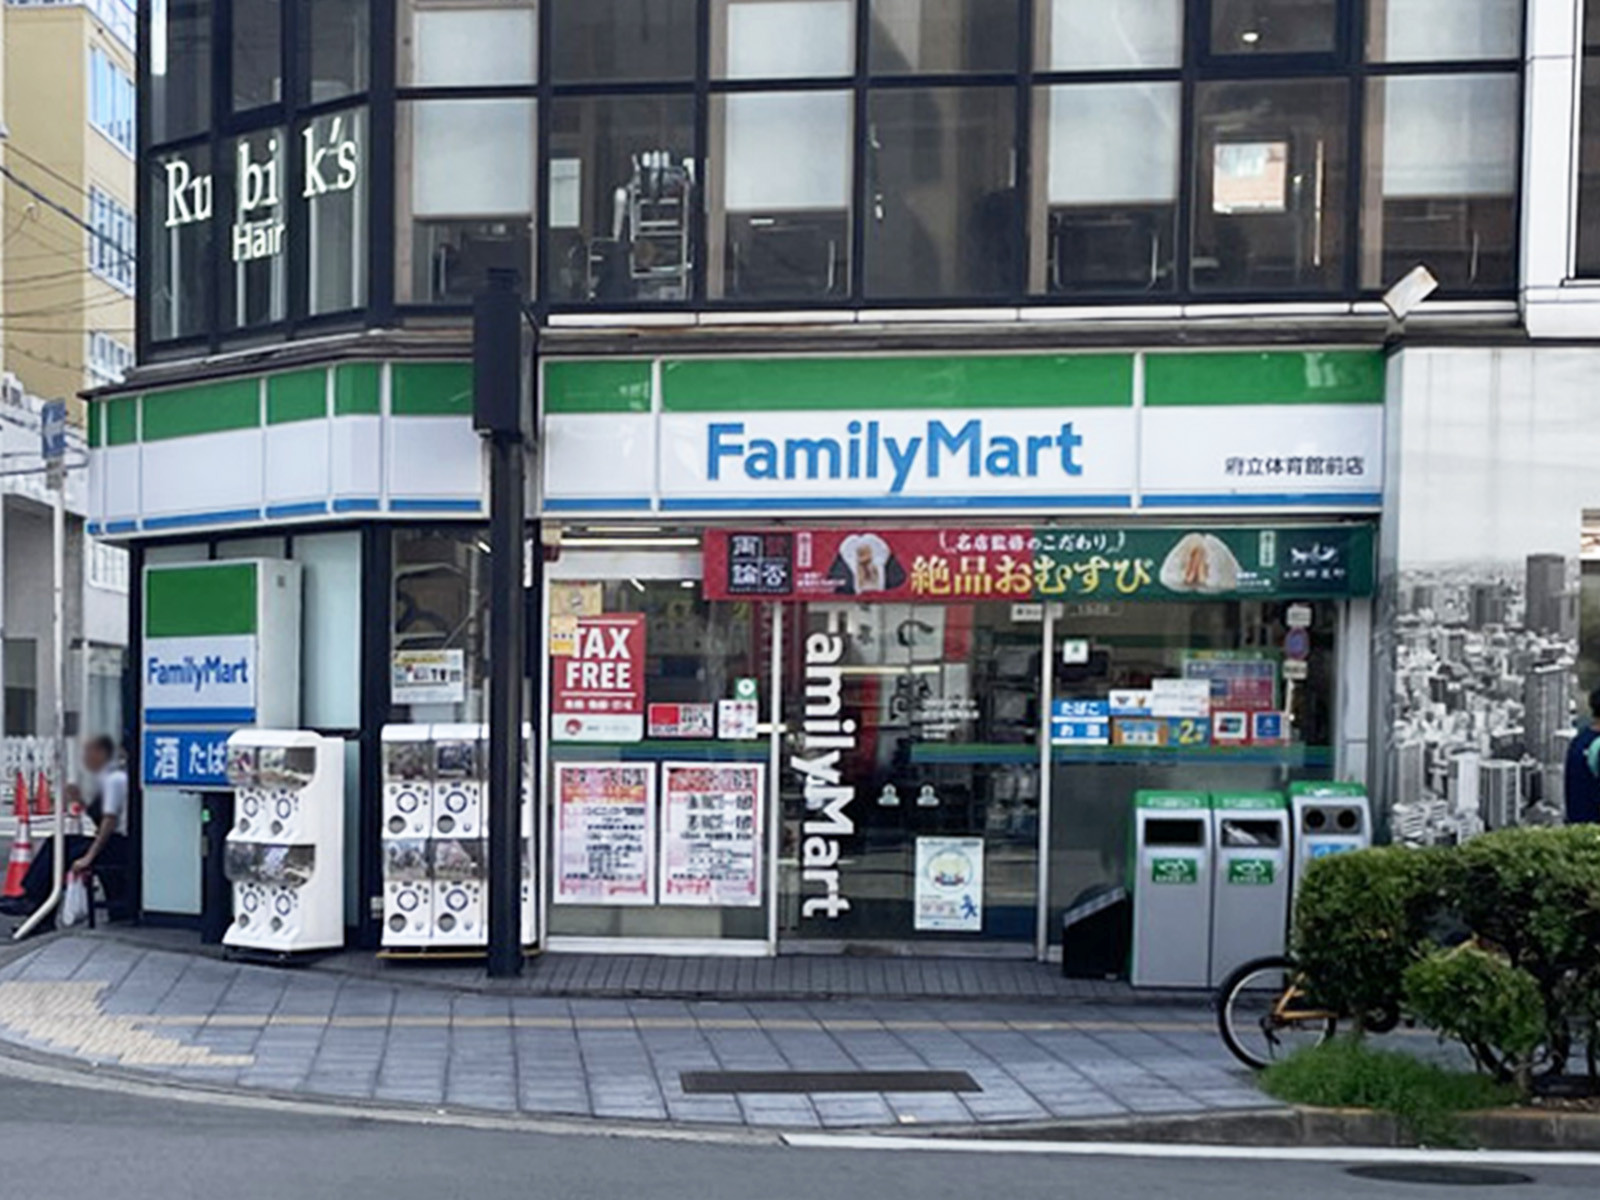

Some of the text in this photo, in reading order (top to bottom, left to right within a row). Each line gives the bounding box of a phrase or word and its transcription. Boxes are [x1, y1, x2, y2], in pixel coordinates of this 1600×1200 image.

[232, 222, 285, 262] Hair
[706, 418, 1084, 494] FamilyMart
[1224, 455, 1366, 477] 府立体育館前店
[910, 554, 1155, 595] 絶品おむすび
[573, 627, 631, 659] TAX
[147, 655, 248, 692] FamilyMart
[566, 662, 631, 689] FREE
[153, 737, 227, 780] 酒 たば
